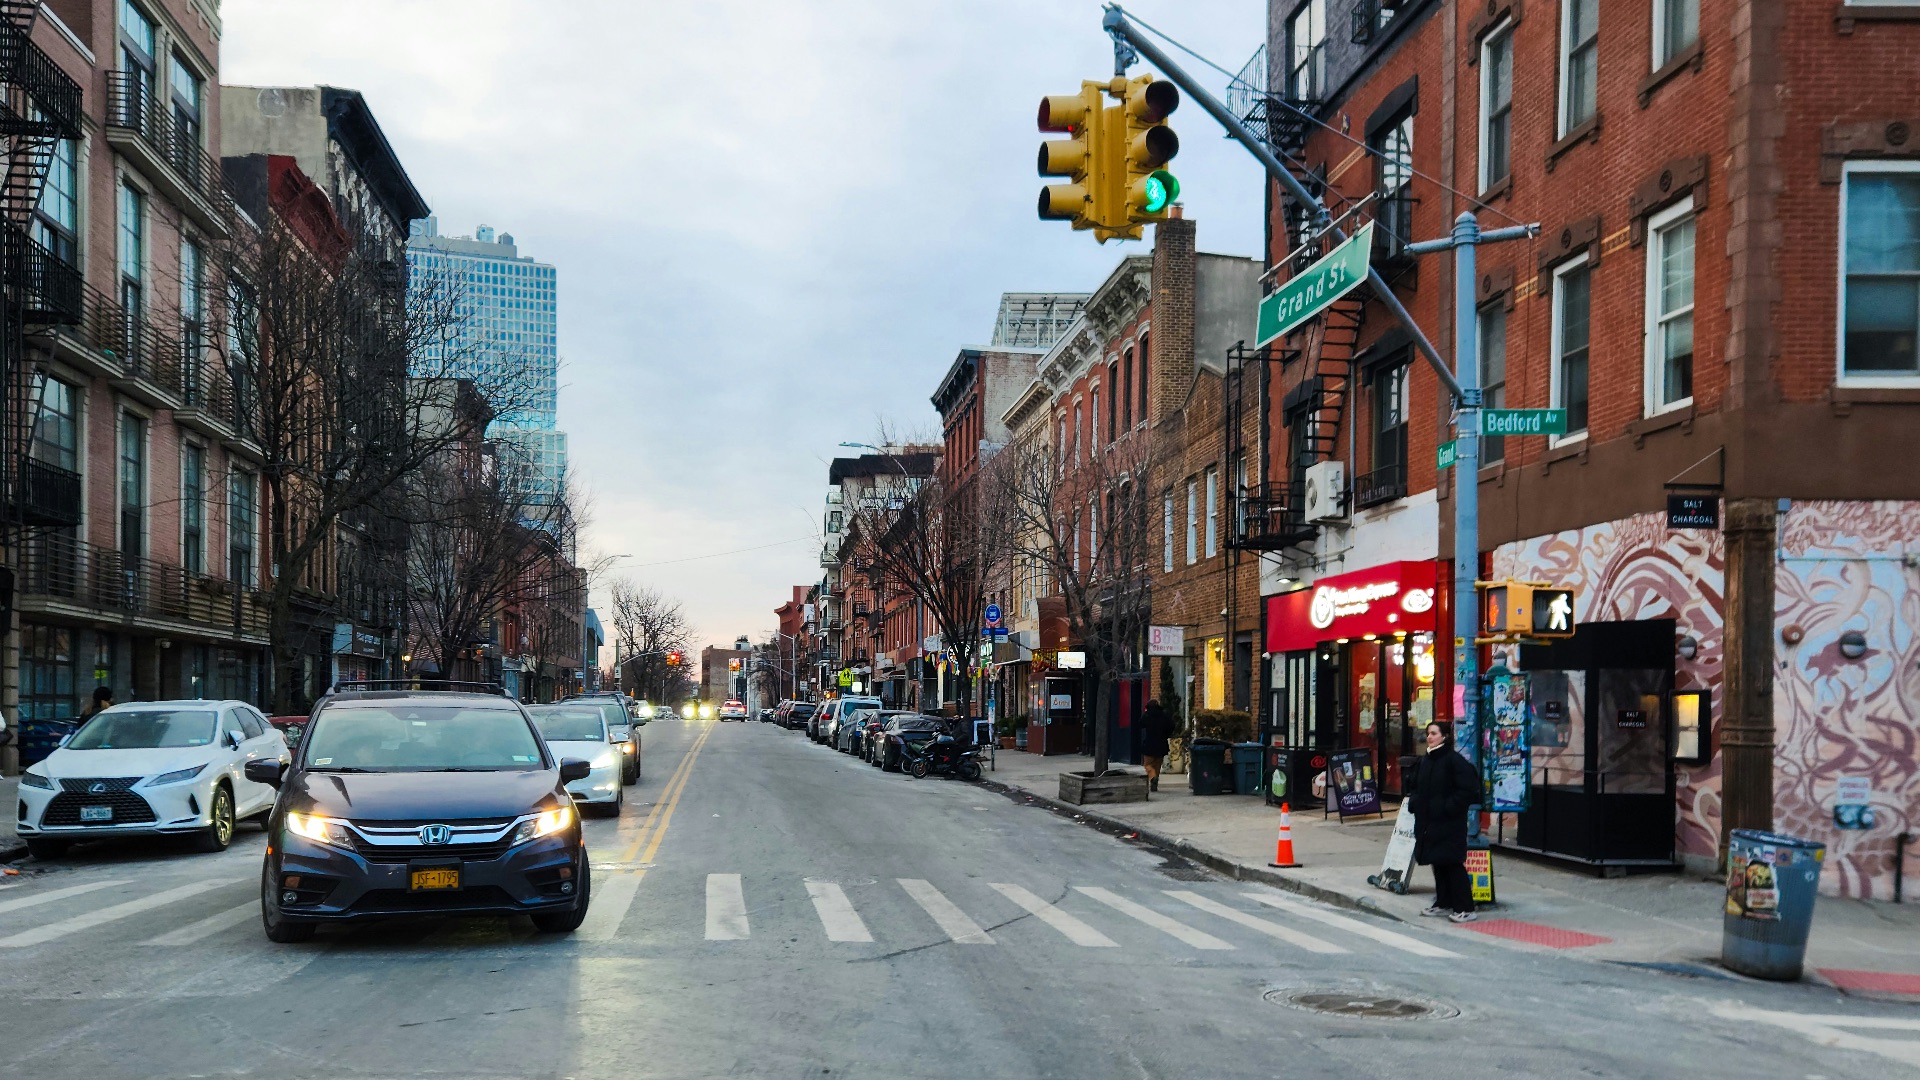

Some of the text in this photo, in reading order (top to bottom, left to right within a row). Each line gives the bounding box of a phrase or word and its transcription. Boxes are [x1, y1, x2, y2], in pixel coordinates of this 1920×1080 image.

[1278, 255, 1348, 323] Grand St
[1487, 411, 1557, 432] Bedford Av
[1438, 444, 1454, 467] Grand
[1683, 499, 1703, 509] SALT
[1672, 514, 1714, 524] CHARCOAL
